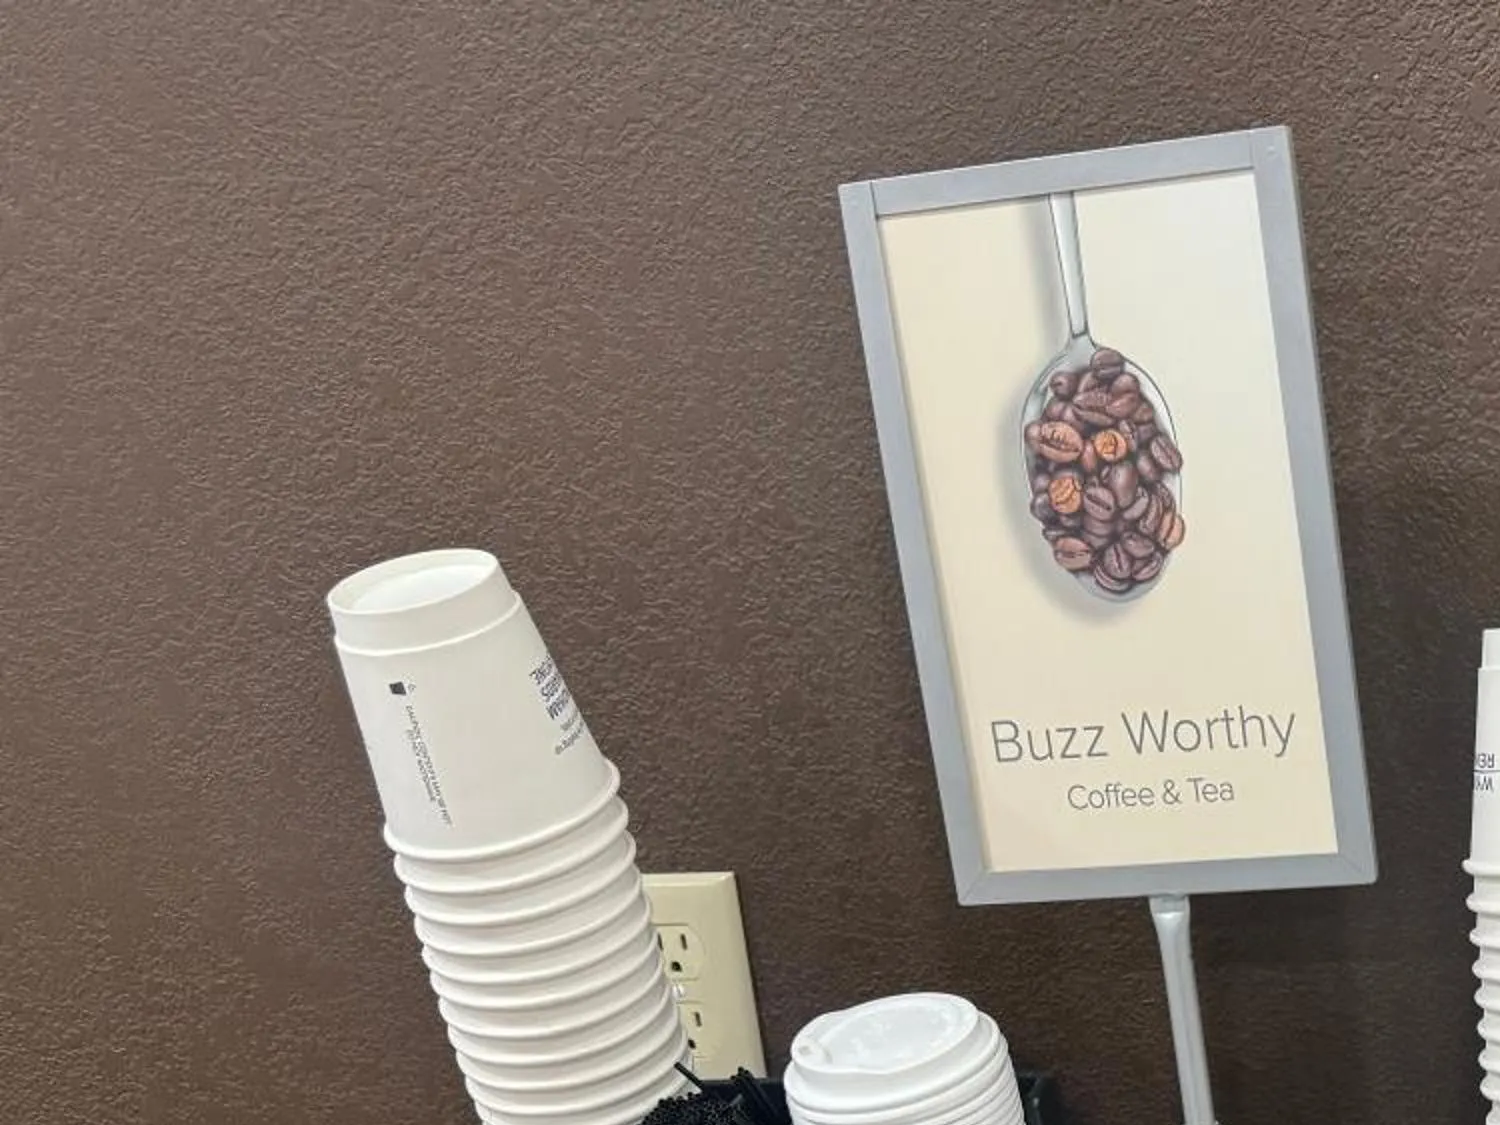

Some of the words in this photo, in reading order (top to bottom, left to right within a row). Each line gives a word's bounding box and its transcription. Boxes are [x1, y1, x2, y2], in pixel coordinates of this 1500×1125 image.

[990, 719, 1108, 764] Buzz
[1121, 704, 1296, 757] Worthy
[1067, 782, 1154, 811] Coffee
[1163, 780, 1182, 804] &
[1187, 777, 1236, 803] Tea
